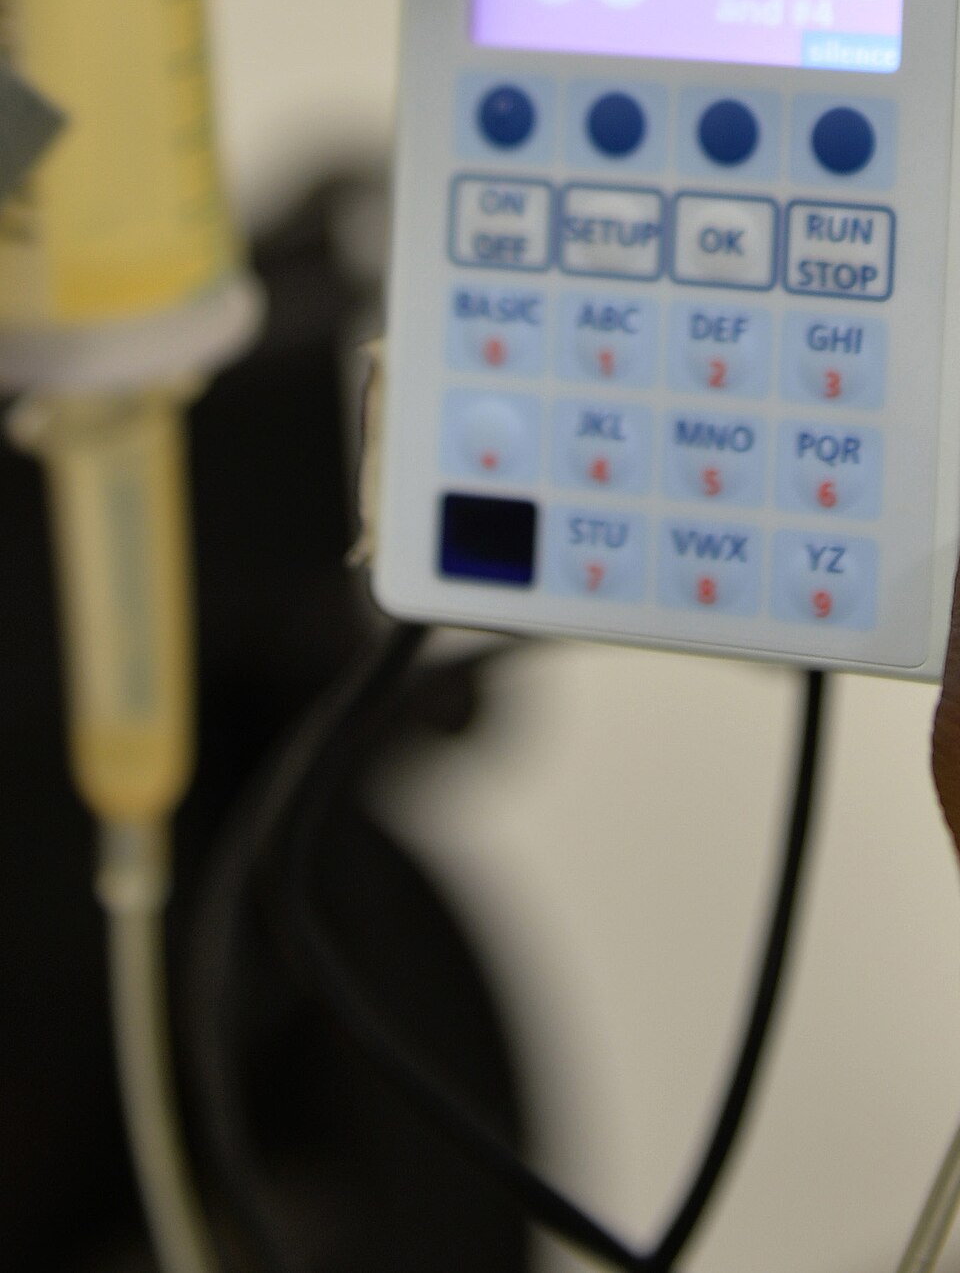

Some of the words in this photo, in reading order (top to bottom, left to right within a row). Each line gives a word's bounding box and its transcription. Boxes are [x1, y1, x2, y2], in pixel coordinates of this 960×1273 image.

[808, 40, 897, 67] silence
[479, 189, 525, 216] ON
[565, 215, 660, 247] SETUP
[699, 227, 745, 255] OK
[806, 213, 873, 245] RUN
[475, 234, 528, 263] OFF
[797, 260, 878, 291] STOP
[454, 291, 542, 325] BASIC
[577, 304, 640, 334] ABC
[689, 313, 749, 344] DEF
[807, 323, 864, 355] GHI
[598, 351, 615, 378] 1
[708, 359, 727, 388] 2
[823, 369, 842, 399] 3
[576, 410, 627, 441] JKL
[674, 419, 755, 453] MNO
[797, 432, 862, 466] PQR
[589, 455, 611, 484] 4
[703, 467, 723, 497] 5
[817, 479, 838, 509] 6
[568, 517, 630, 550] STU
[670, 530, 748, 563] VWX
[805, 543, 846, 575] YZ
[584, 562, 605, 594] 7
[697, 576, 718, 605] 8
[812, 588, 833, 620] 9
